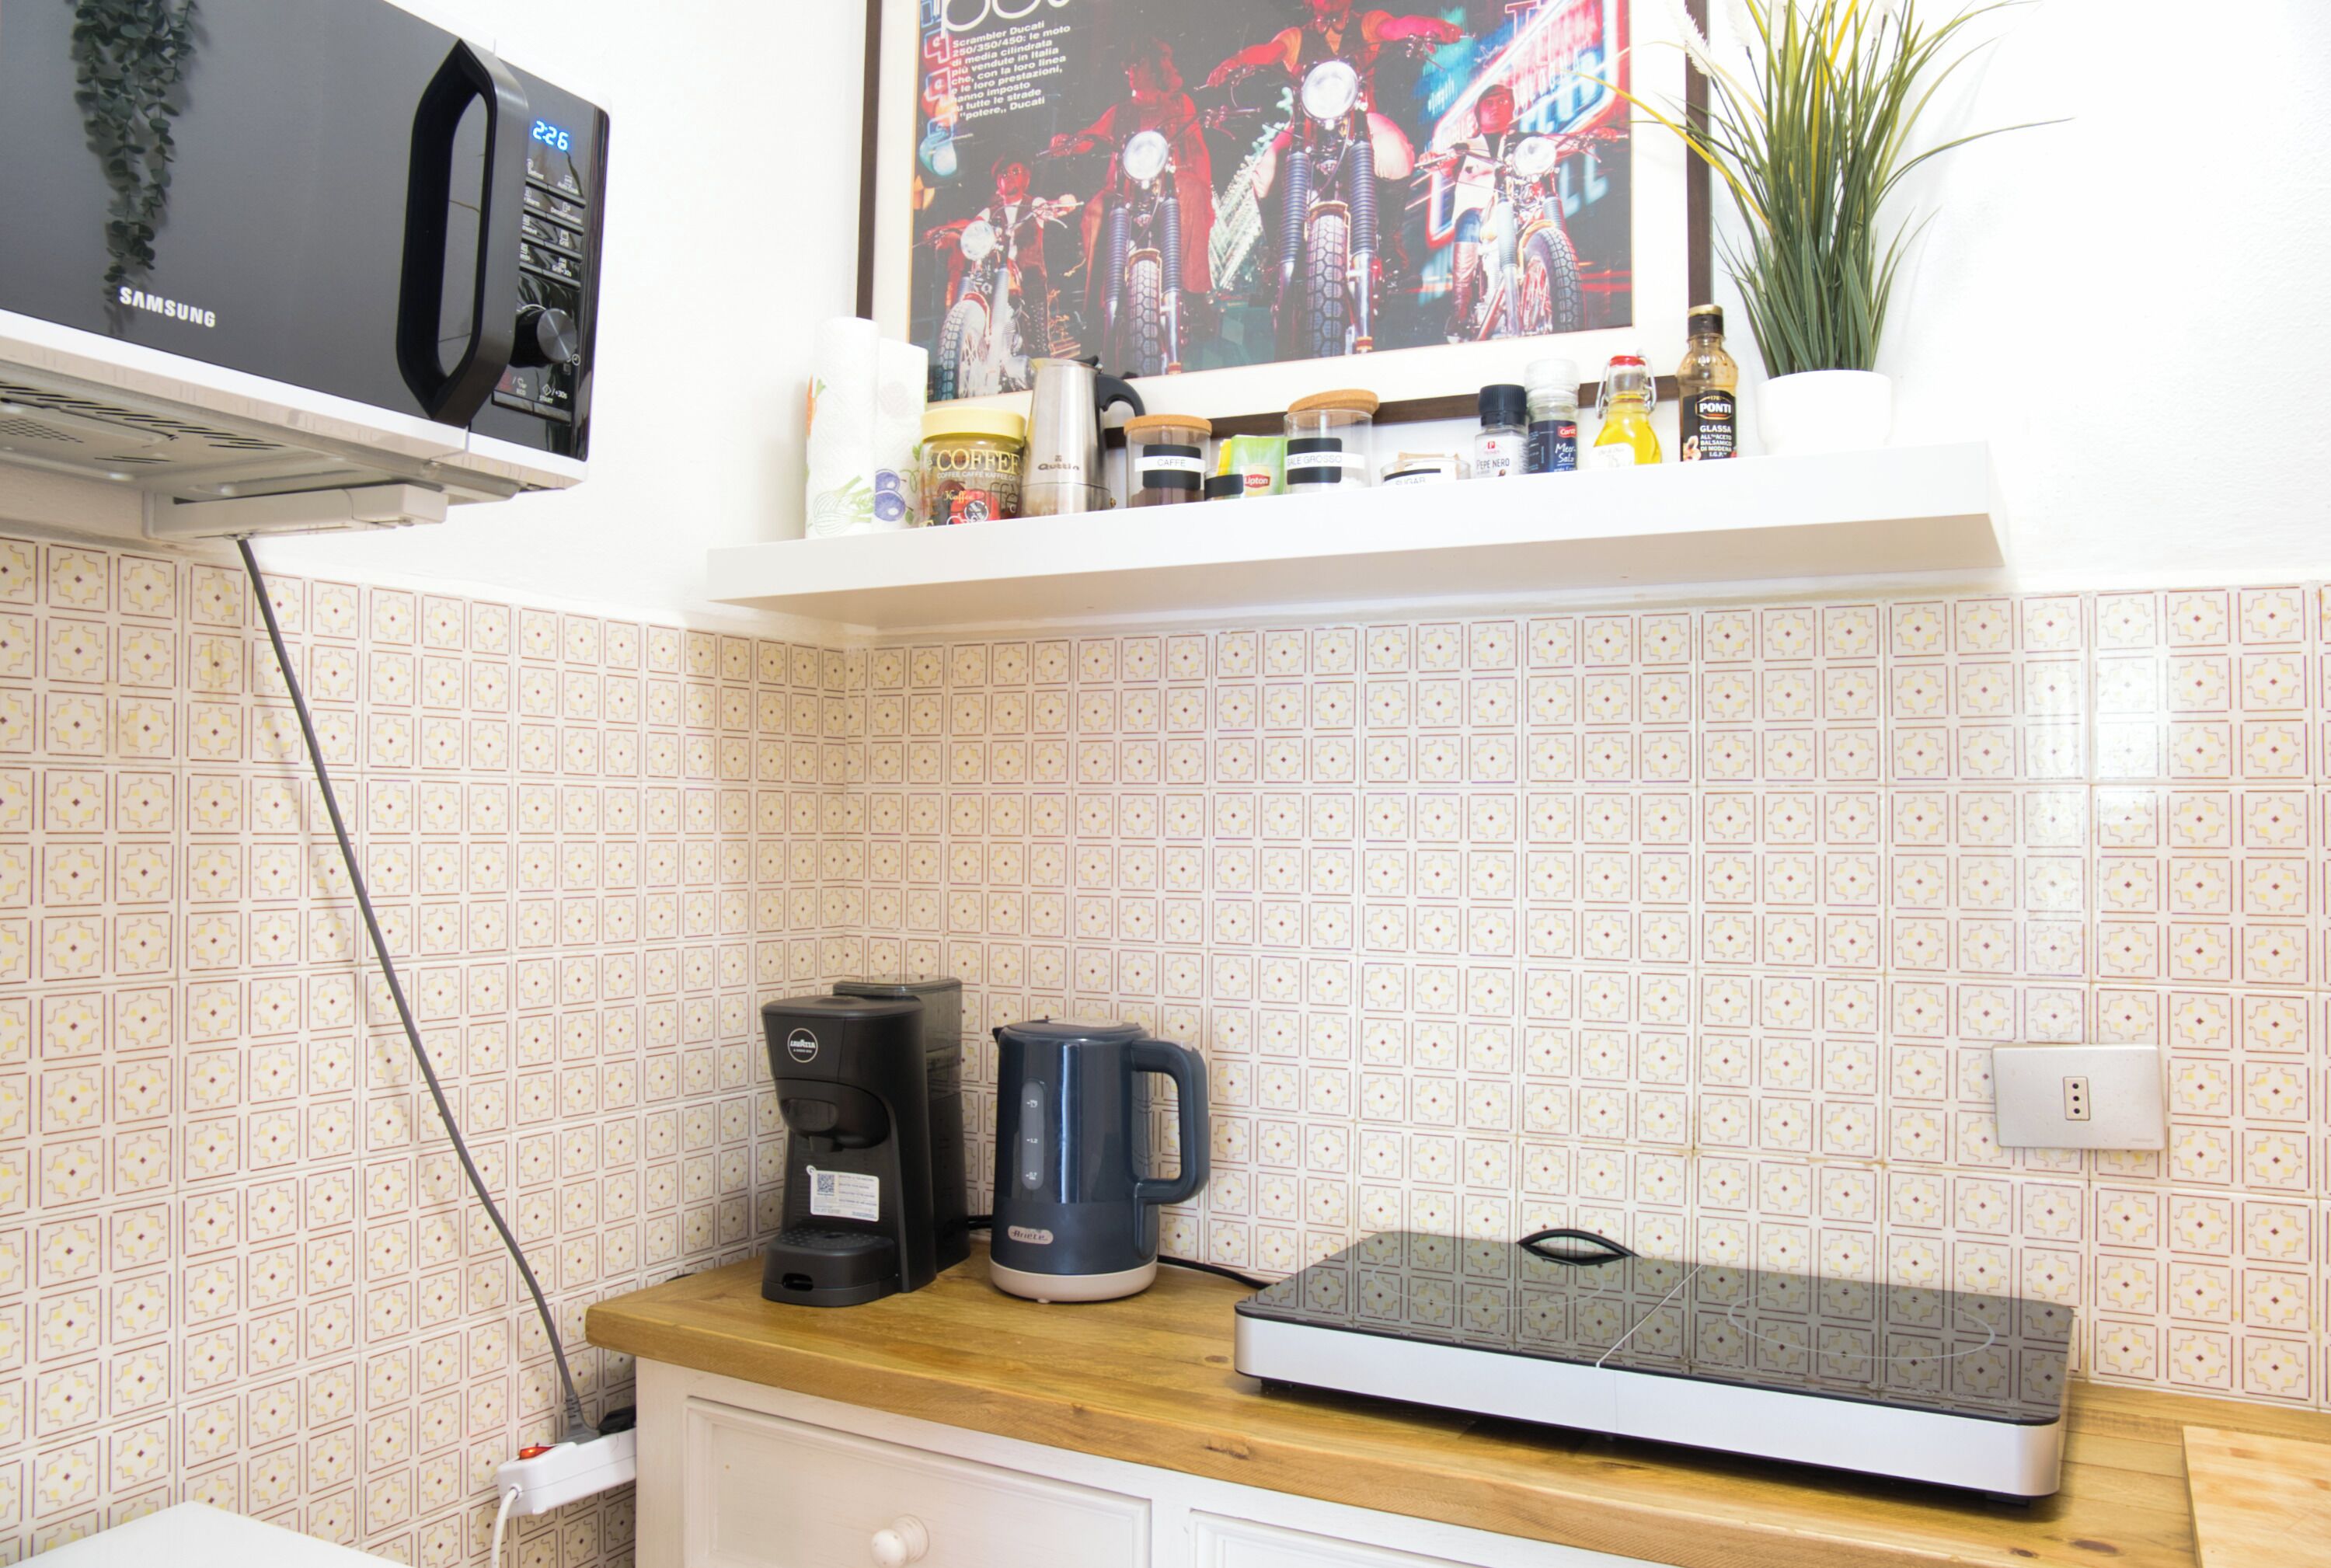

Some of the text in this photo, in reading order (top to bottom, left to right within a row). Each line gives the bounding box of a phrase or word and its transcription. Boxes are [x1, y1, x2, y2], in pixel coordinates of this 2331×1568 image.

[953, 20, 1045, 48] Scrambler Ducati
[953, 26, 1071, 57] 250/350/450: le moto
[951, 47, 1059, 78] più vendute in Italia
[952, 40, 1053, 67] di media cilindrata
[951, 55, 1067, 85] che, con la loro linea
[960, 83, 971, 93] le
[974, 78, 995, 90] loro
[998, 65, 1063, 86] prestazioni,
[966, 99, 991, 110] tutte
[994, 96, 1004, 105] le
[1006, 89, 1042, 102] strade
[987, 82, 1031, 96] imposto
[1009, 96, 1045, 111] Ducati
[532, 120, 569, 151] 2:26
[119, 286, 216, 329] SAMSUNG
[1699, 403, 1731, 413] PONTI
[1287, 455, 1343, 466] SALE GROSSO
[1476, 457, 1510, 470] PEPE NERO
[1244, 476, 1269, 486] Lipton
